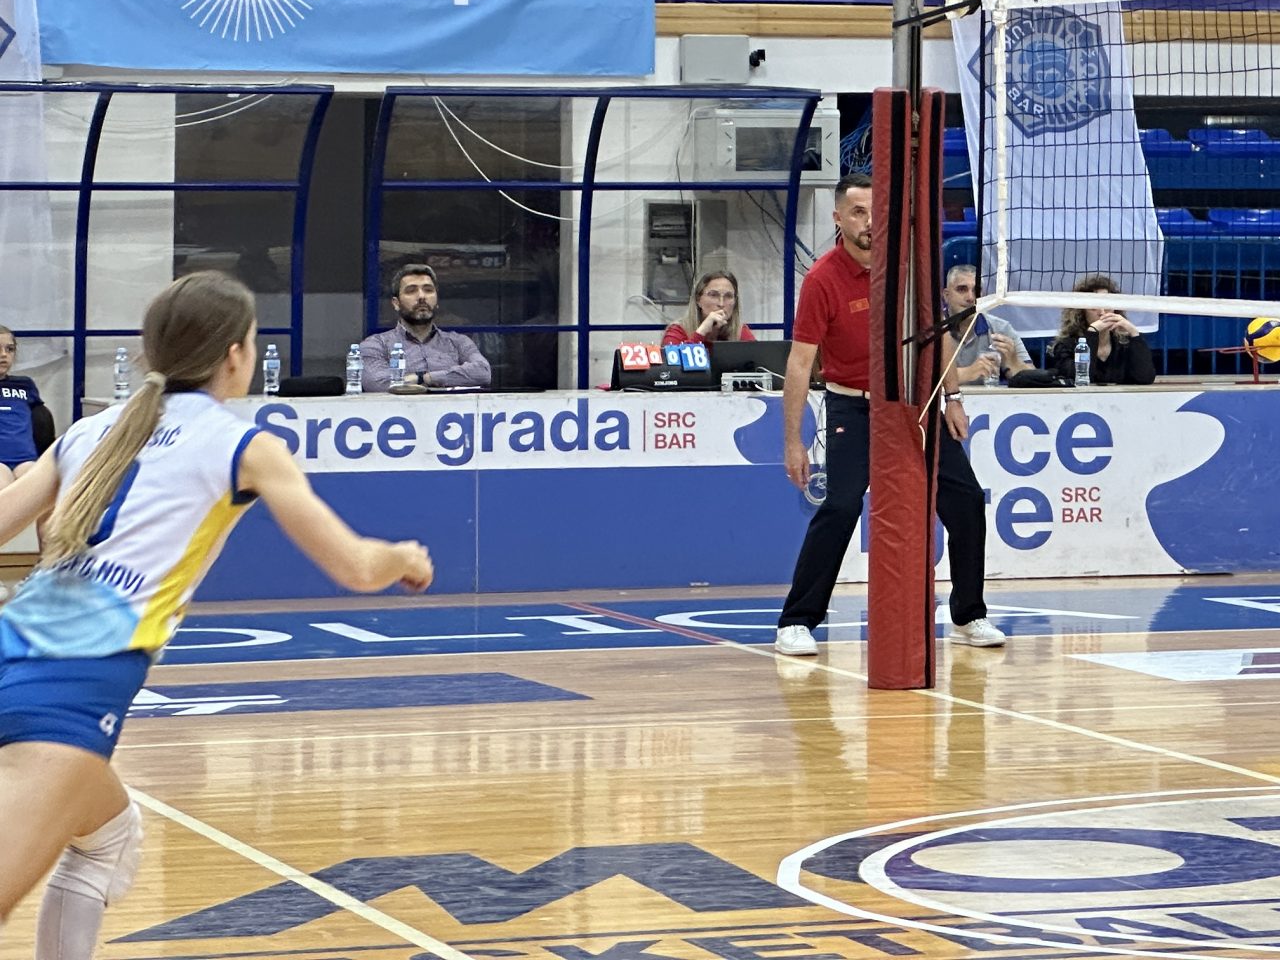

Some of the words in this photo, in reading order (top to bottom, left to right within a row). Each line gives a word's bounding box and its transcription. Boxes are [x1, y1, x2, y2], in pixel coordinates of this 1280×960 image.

[620, 345, 648, 367] 23
[681, 345, 708, 368] 18
[2, 388, 28, 401] BAR
[654, 411, 696, 429] SRC
[254, 402, 416, 460] Srce
[436, 398, 630, 466] grada
[654, 432, 696, 449] BAR
[1061, 486, 1101, 503] SRC
[1061, 507, 1103, 523] BAR
[96, 559, 145, 595] NOVI
